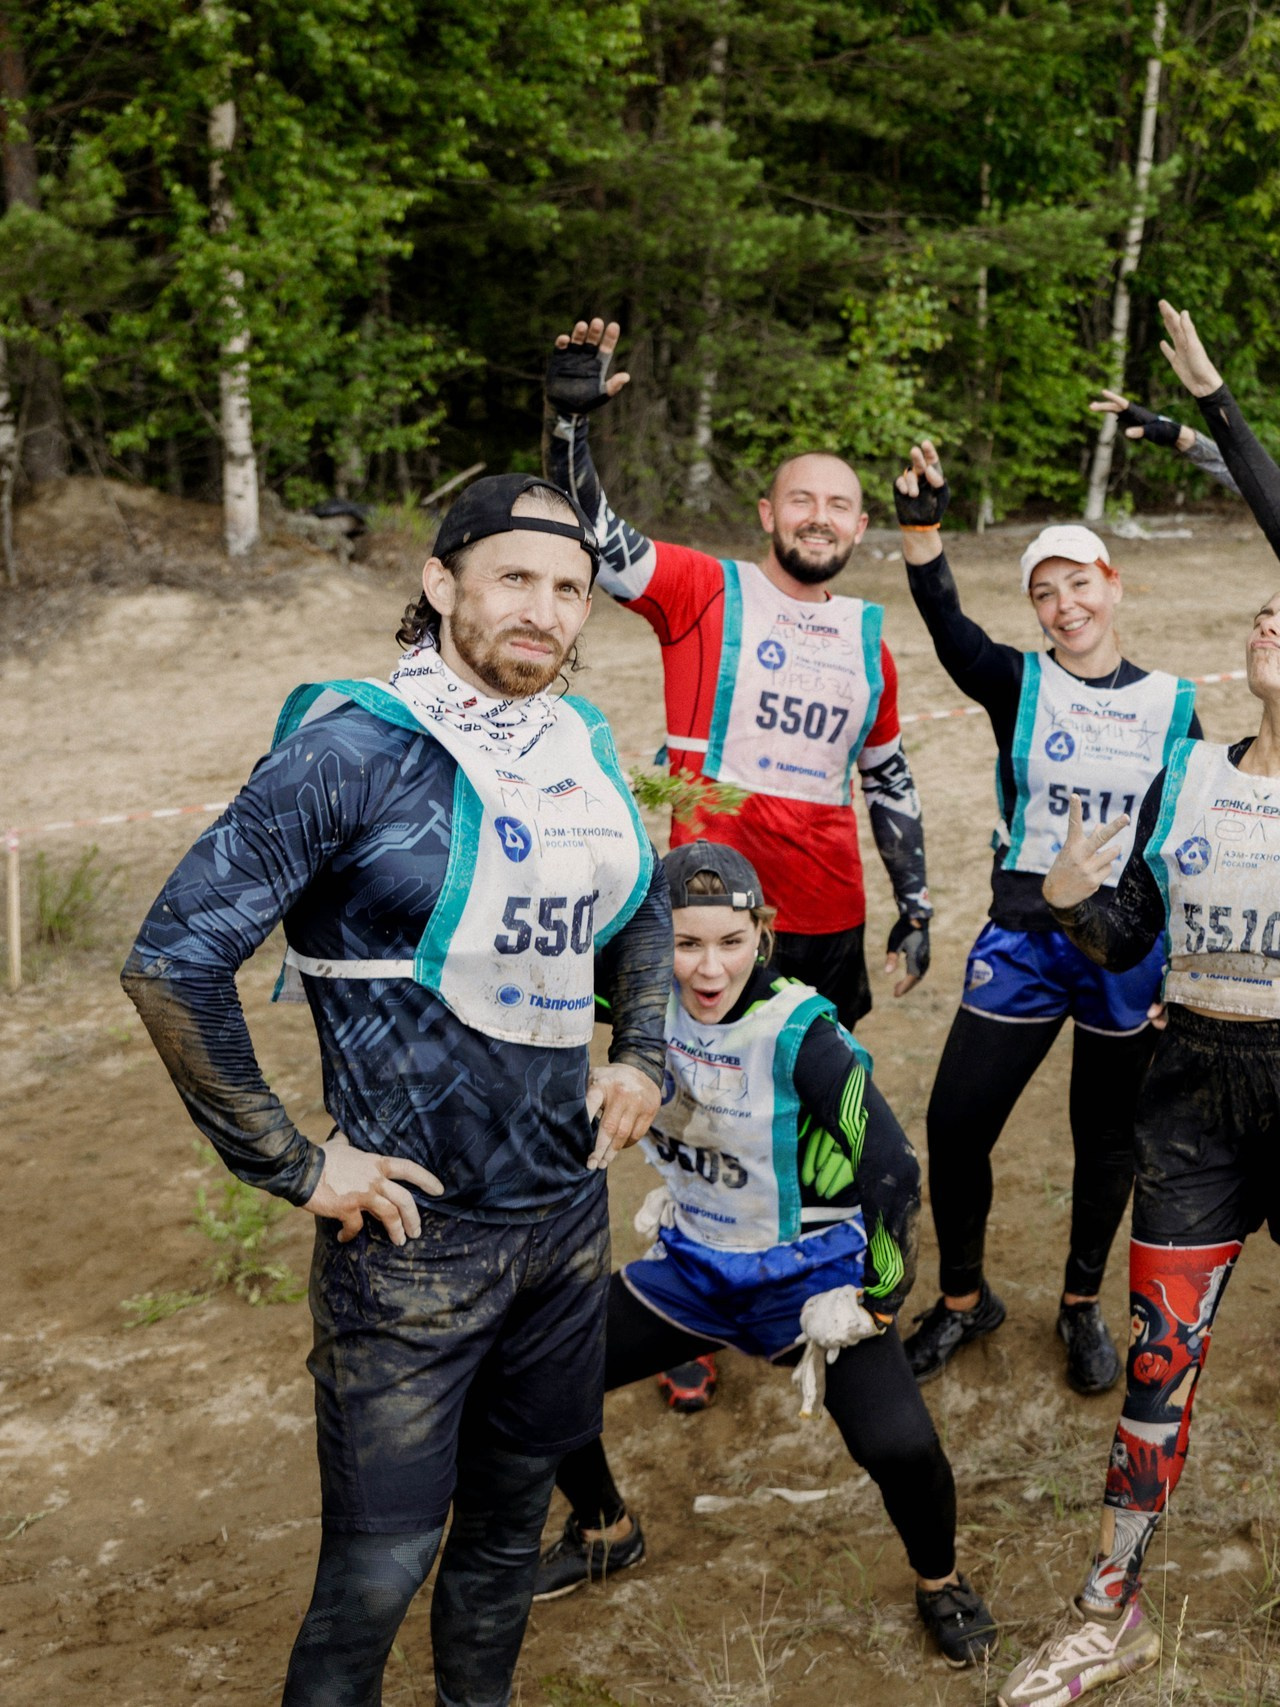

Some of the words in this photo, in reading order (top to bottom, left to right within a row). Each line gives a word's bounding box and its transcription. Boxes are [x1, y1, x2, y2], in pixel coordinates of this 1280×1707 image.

[755, 691, 849, 744] 5507
[1049, 783, 1138, 826] 5511
[1213, 799, 1253, 812] ГОНКА
[544, 826, 623, 840] АЭМ-ТЕХНОЛОГИИ
[494, 894, 598, 957] 550
[529, 992, 594, 1012] ГАЗПРОМБА
